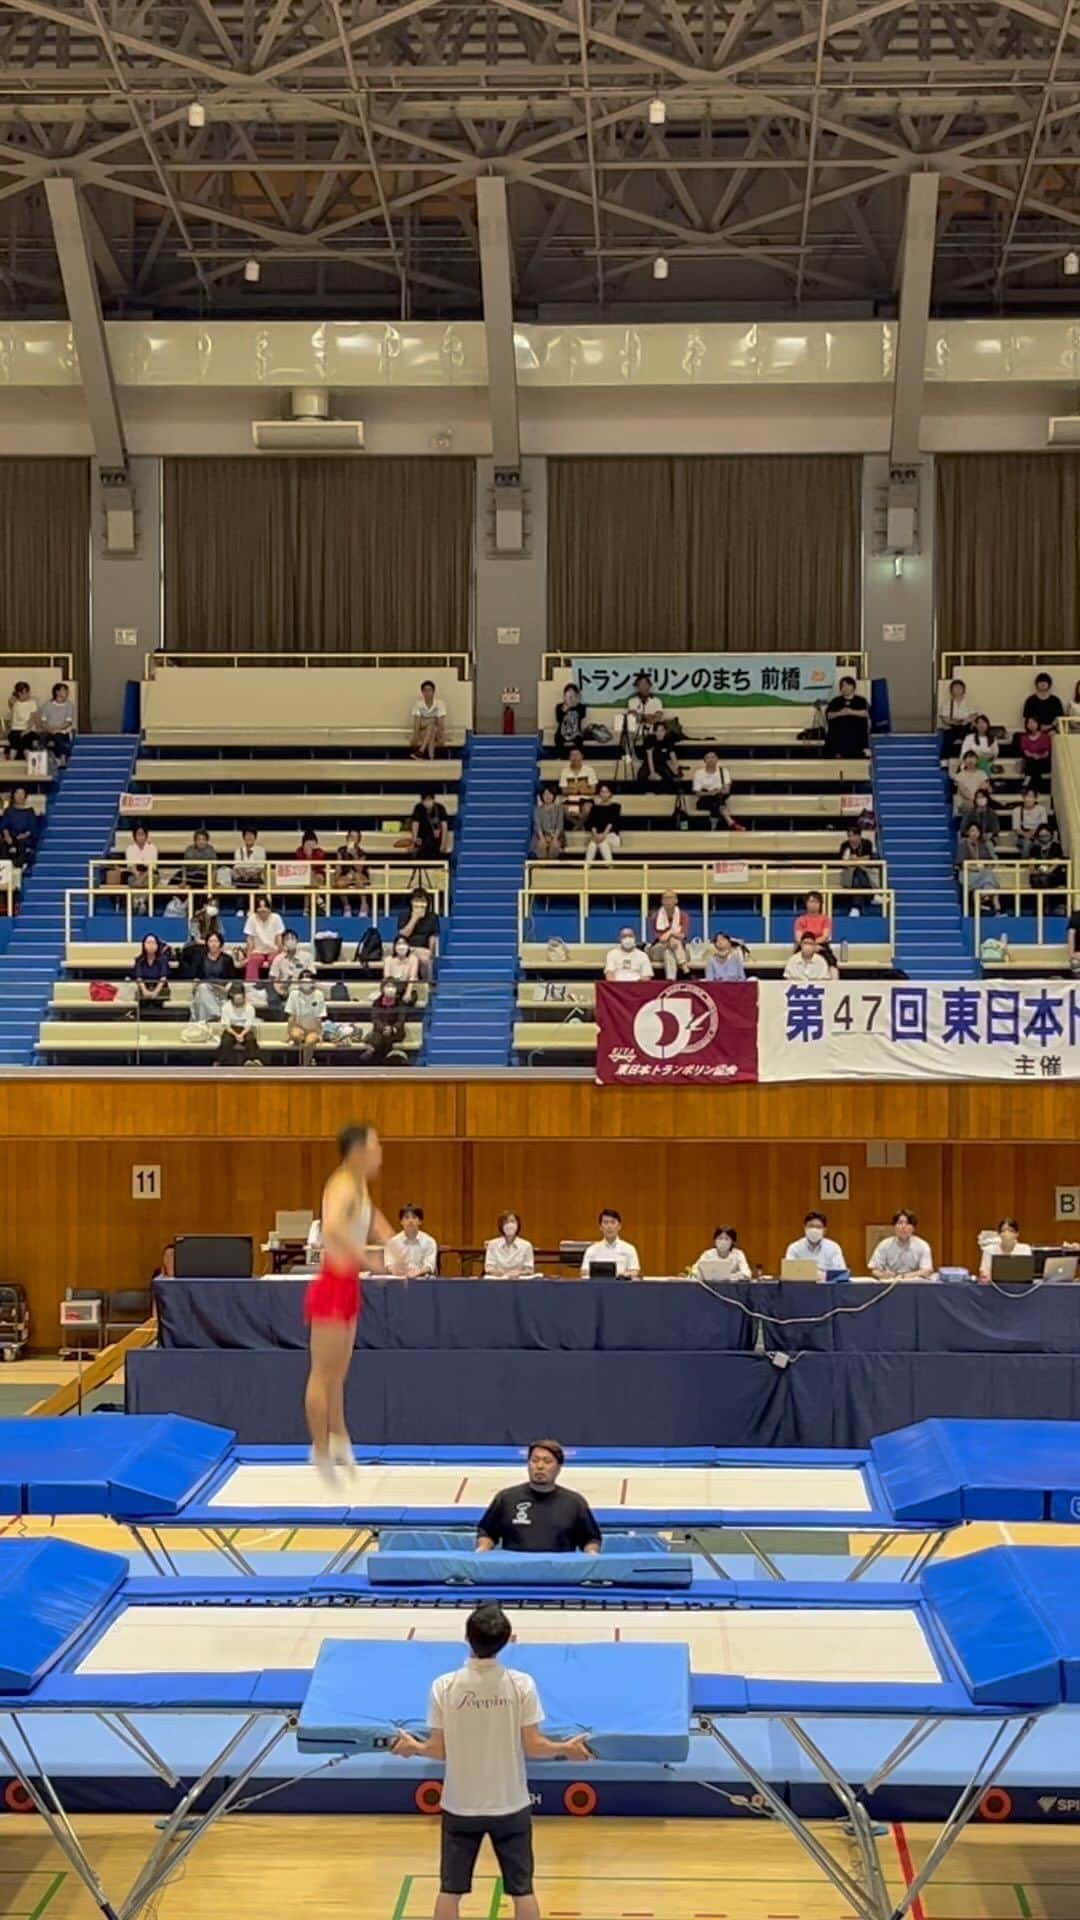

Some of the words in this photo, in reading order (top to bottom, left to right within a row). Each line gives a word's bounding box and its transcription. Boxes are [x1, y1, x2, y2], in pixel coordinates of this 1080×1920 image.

[576, 667, 750, 691] トランポリンのまち
[761, 667, 800, 690] 前橋
[785, 984, 928, 1043] 第47回
[1015, 1054, 1062, 1076] 主催
[136, 1170, 154, 1192] 11
[823, 1171, 847, 1194] 10
[1060, 1194, 1075, 1213] B
